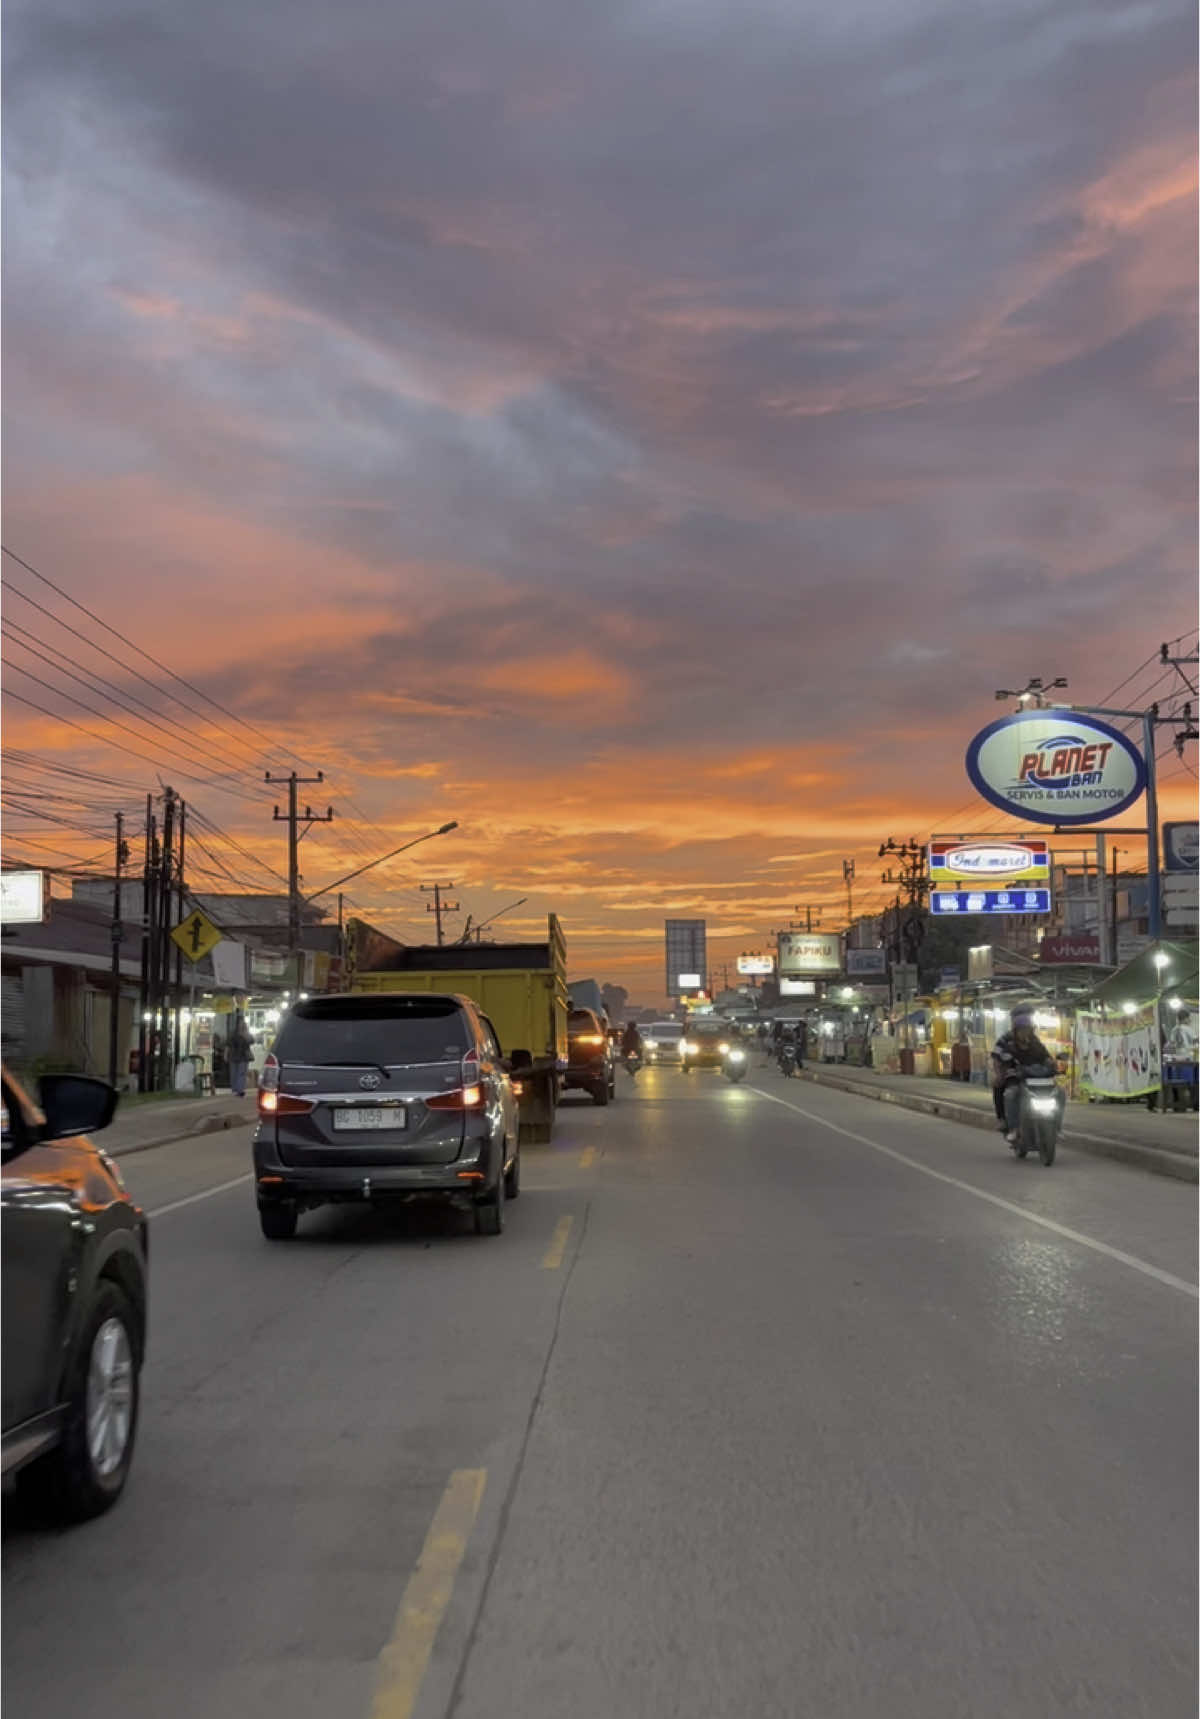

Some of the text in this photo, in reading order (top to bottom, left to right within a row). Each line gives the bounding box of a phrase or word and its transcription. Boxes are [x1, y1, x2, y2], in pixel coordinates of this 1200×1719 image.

[1018, 742, 1113, 780] PLANET
[1070, 771, 1103, 787] BAN
[1007, 789, 1043, 800] SERVIS
[1056, 789, 1080, 799] BAN
[1082, 788, 1125, 799] MOTOR
